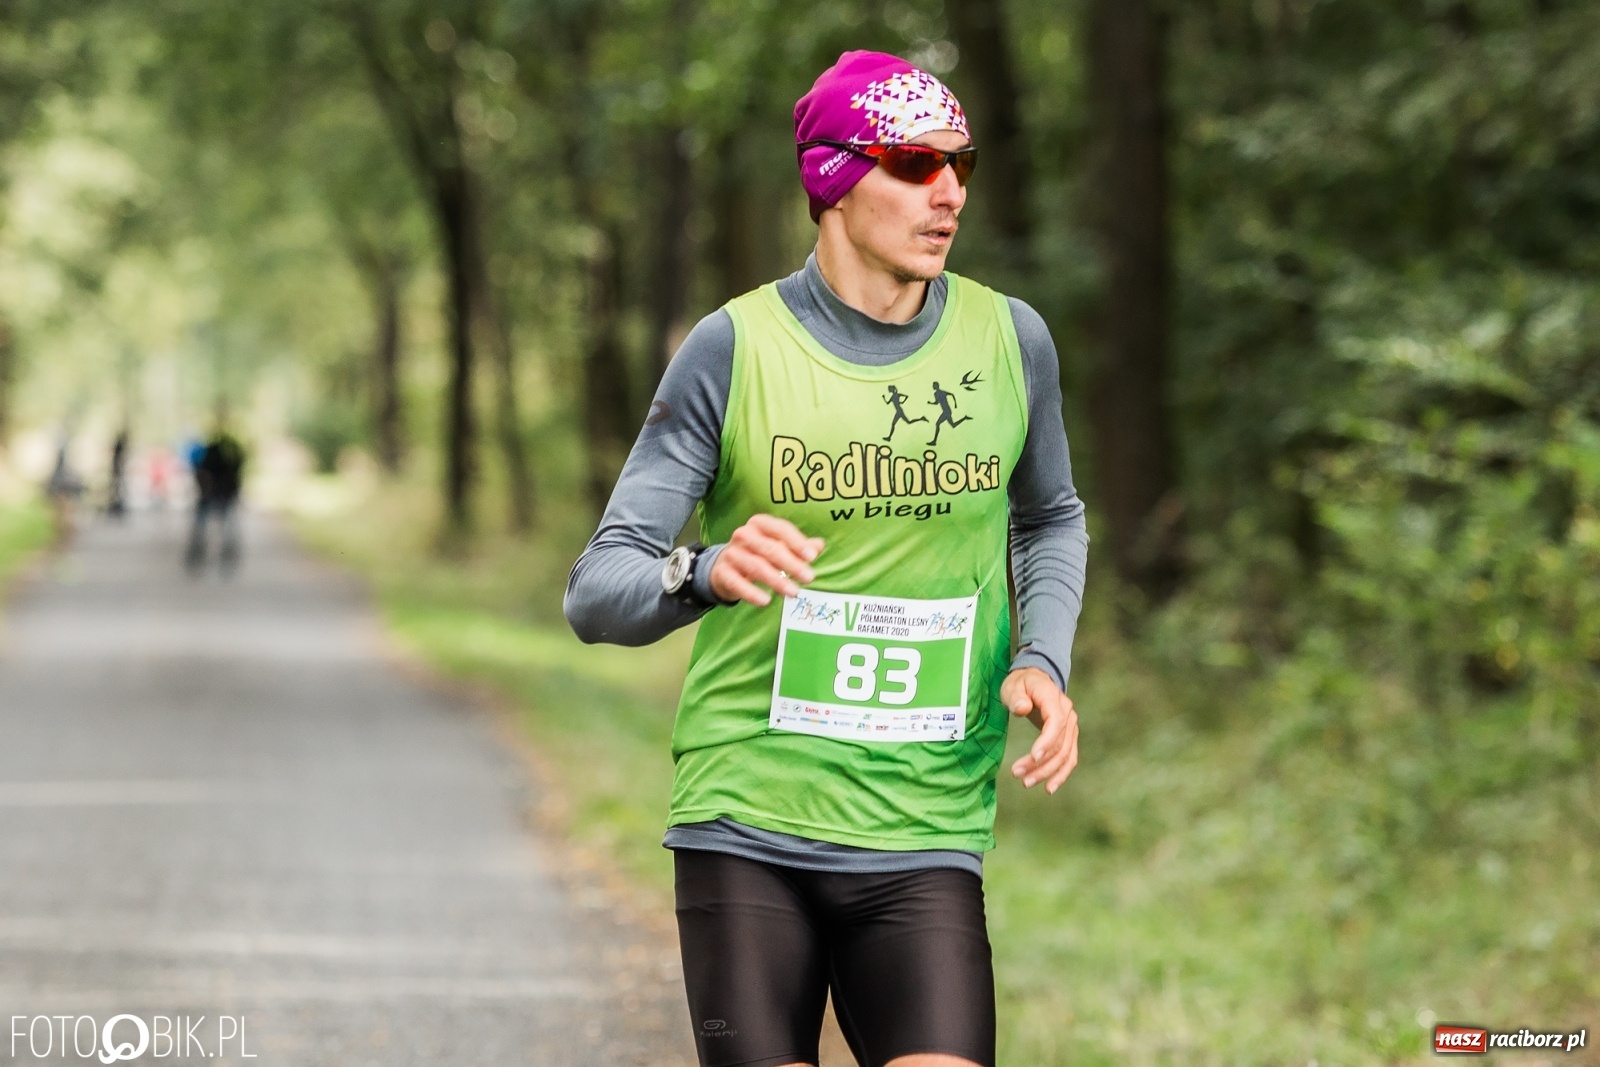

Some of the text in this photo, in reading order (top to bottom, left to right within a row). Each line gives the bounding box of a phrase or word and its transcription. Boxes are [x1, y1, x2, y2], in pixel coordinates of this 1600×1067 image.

[770, 435, 1000, 504] Radlinioki
[830, 501, 951, 521] w biegu
[844, 601, 861, 631] V
[863, 603, 905, 615] KUŹNIAŃSKI
[860, 613, 929, 627] PÓŁMARATON LEŚNY
[857, 624, 910, 637] RAFAMET 2020
[833, 642, 922, 705] 83
